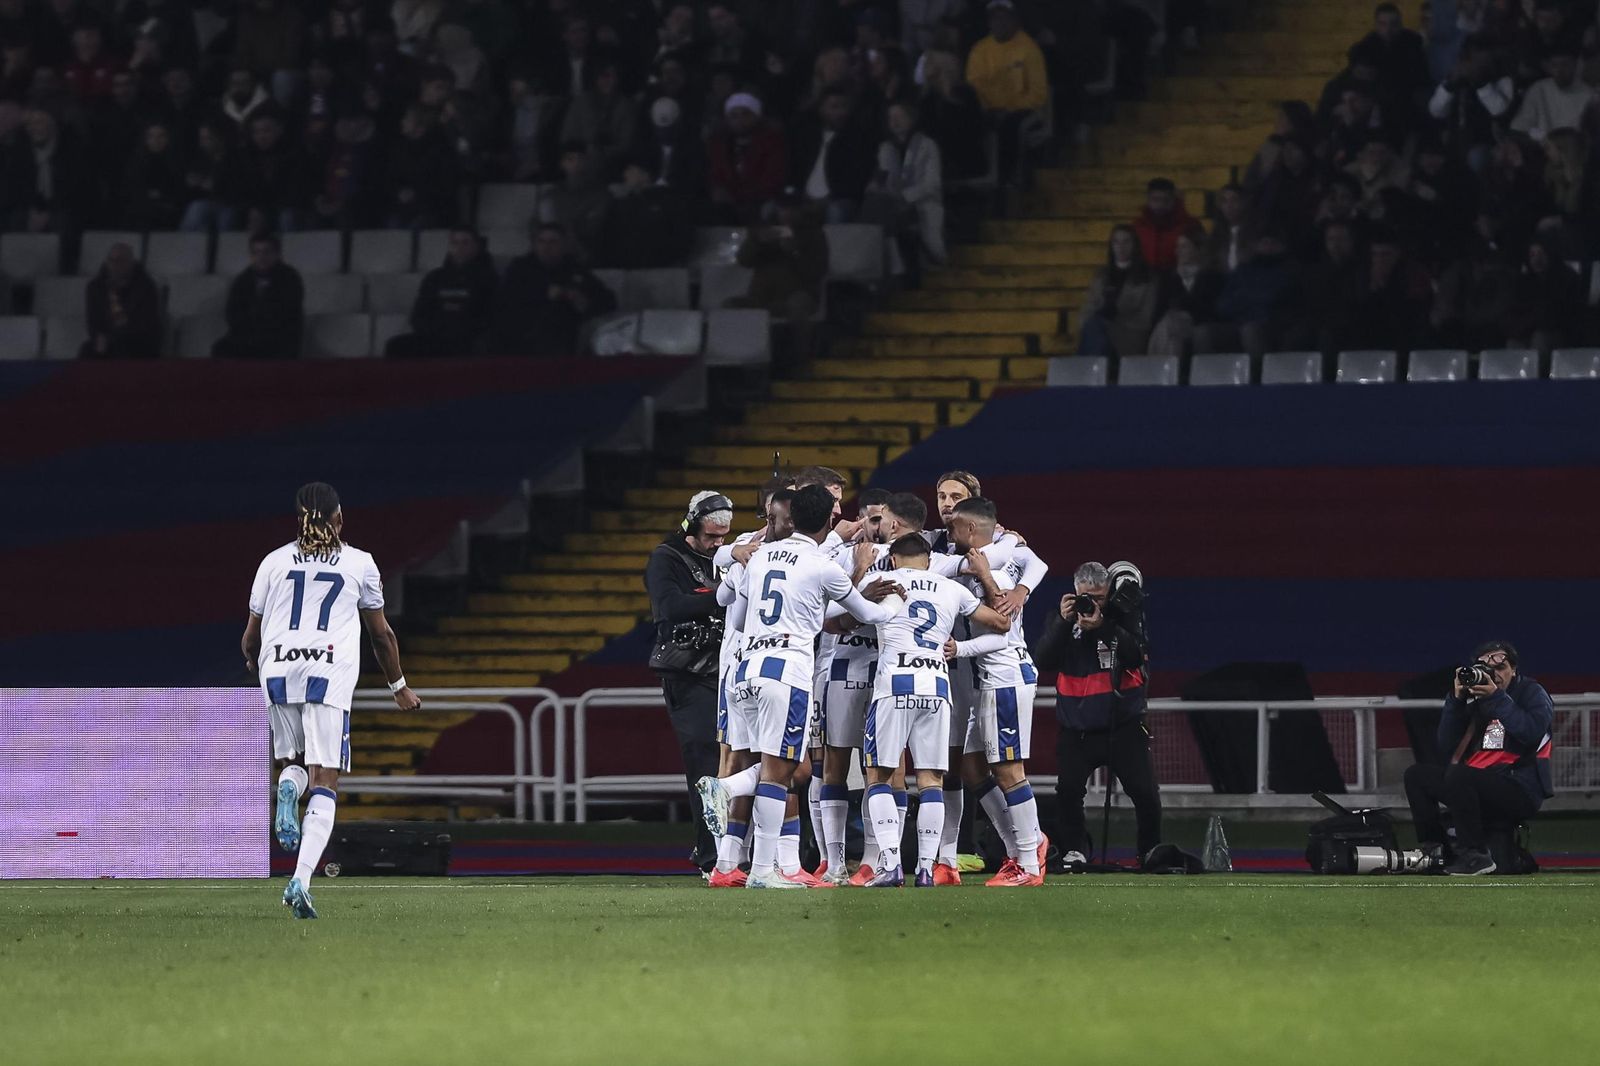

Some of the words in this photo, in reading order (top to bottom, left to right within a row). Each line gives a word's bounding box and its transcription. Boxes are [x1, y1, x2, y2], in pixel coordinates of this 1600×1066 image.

[292, 549, 340, 566] NEYOU
[767, 550, 799, 566] TAPIA
[906, 580, 938, 592] .ALTI
[286, 570, 346, 632] 17
[759, 569, 787, 626] 5
[908, 600, 940, 651] 2
[745, 633, 790, 652] Lowi
[274, 644, 334, 664] Lowi
[894, 694, 943, 713] Ebury
